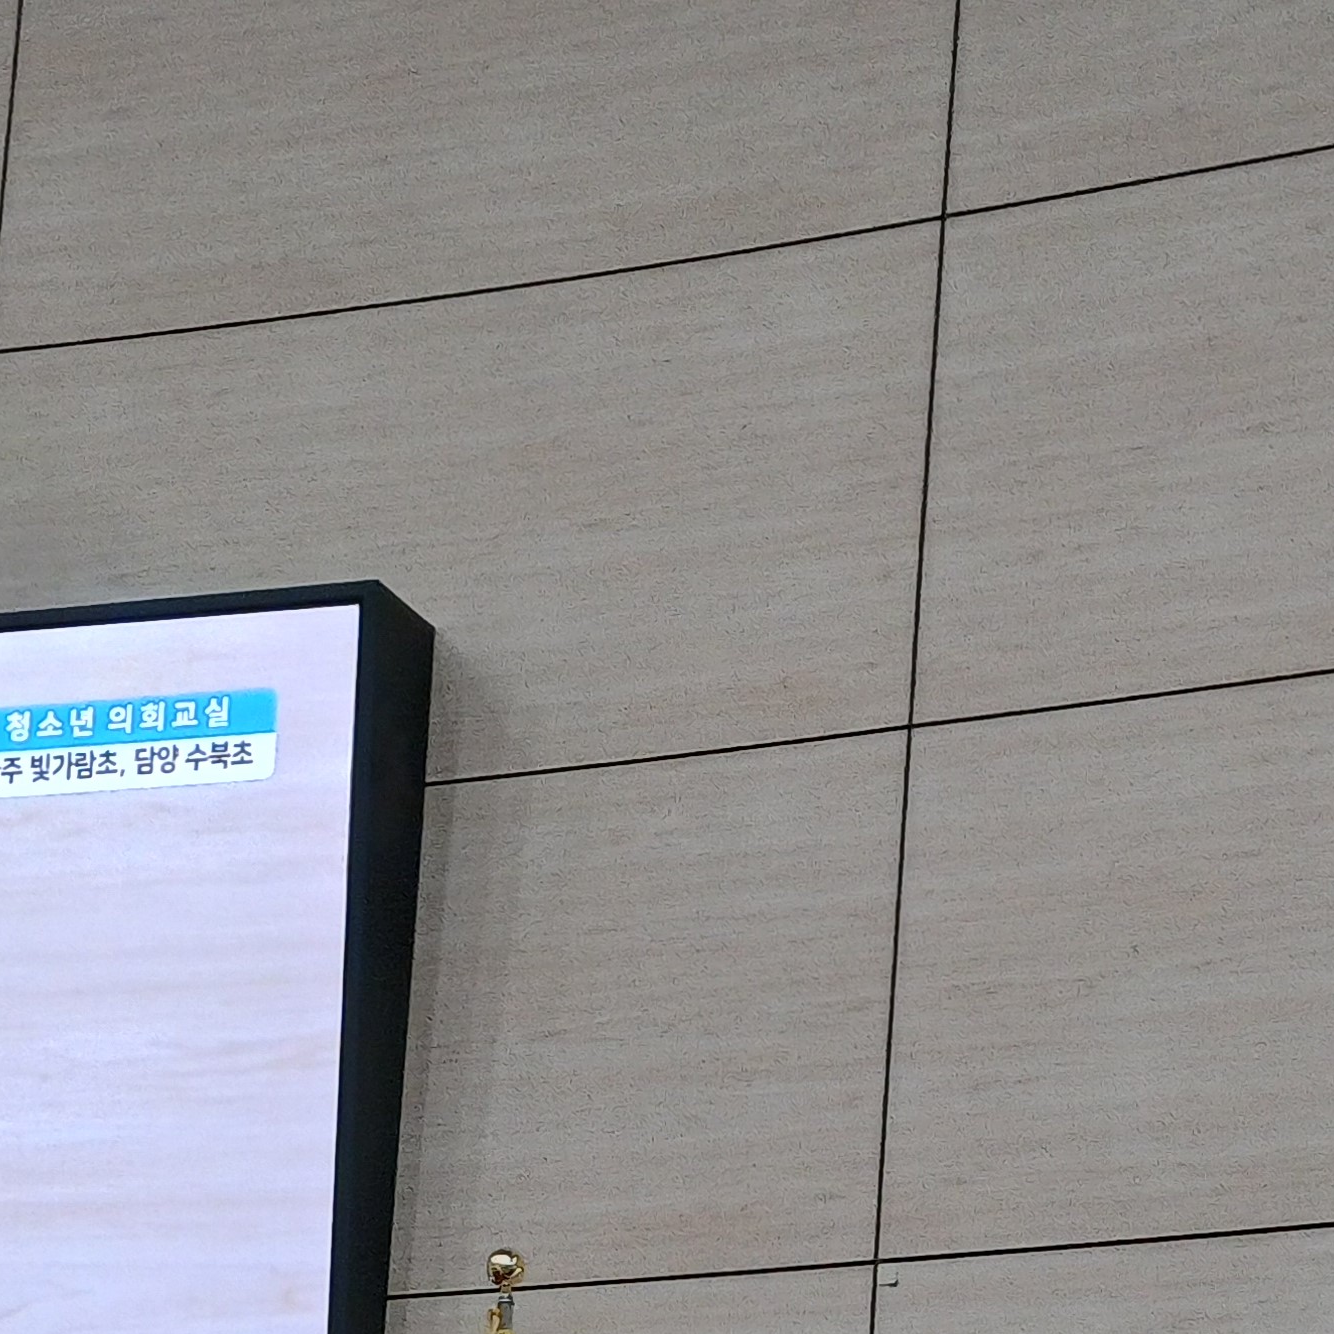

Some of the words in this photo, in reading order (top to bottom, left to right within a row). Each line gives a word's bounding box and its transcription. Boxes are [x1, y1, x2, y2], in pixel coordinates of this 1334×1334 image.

[5, 705, 95, 742] 청소년
[107, 695, 230, 733] 의회교실
[30, 749, 125, 783] 빛가람초,
[133, 744, 180, 775] 담양
[184, 740, 254, 772] 수북초
